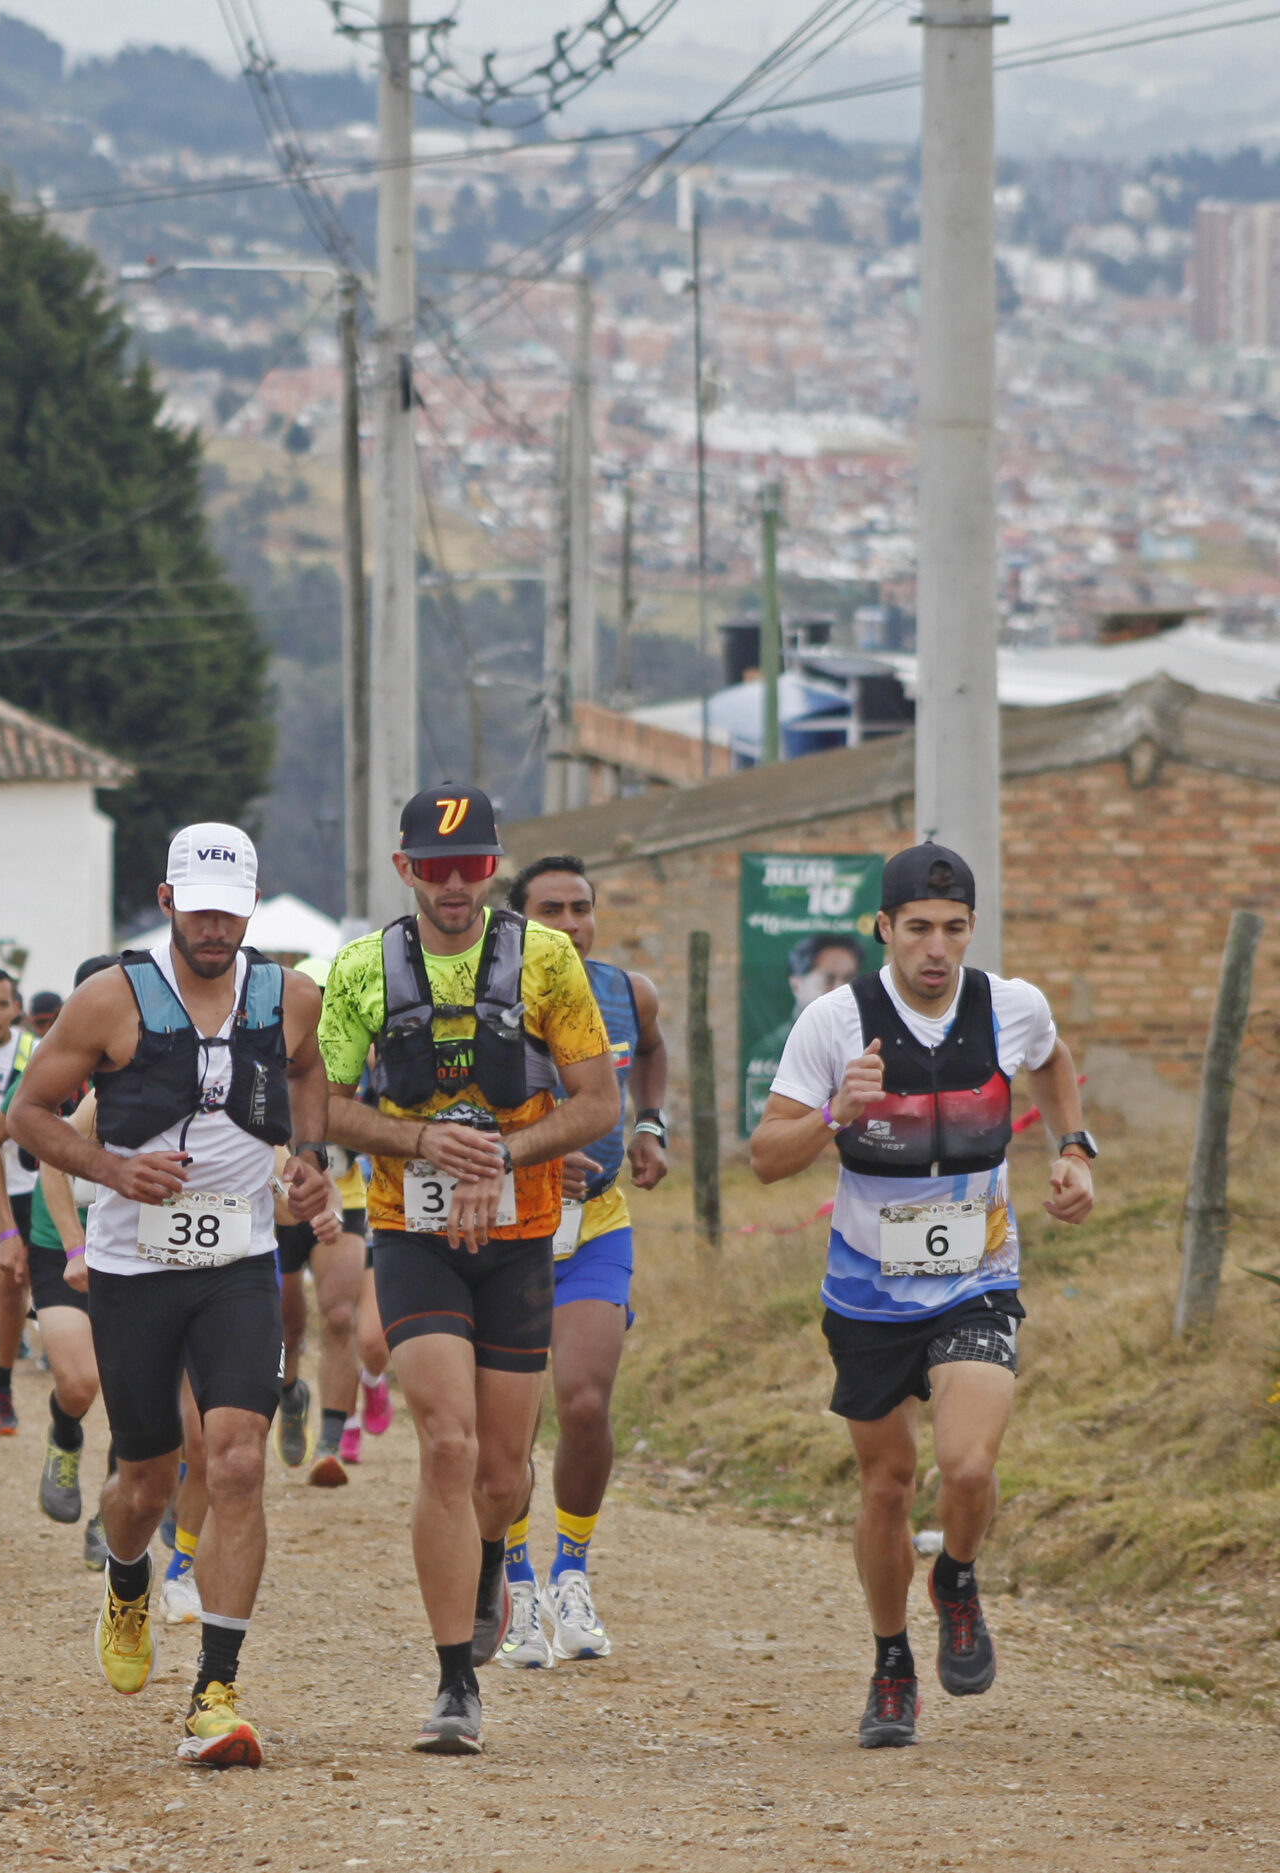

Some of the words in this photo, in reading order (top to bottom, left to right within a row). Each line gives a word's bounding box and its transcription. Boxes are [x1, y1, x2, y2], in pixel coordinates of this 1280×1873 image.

[197, 848, 236, 863] VEN
[807, 886, 852, 915] 10
[422, 1181, 456, 1213] 3
[168, 1212, 220, 1248] 38
[925, 1224, 949, 1257] 6
[562, 1542, 586, 1558] EC
